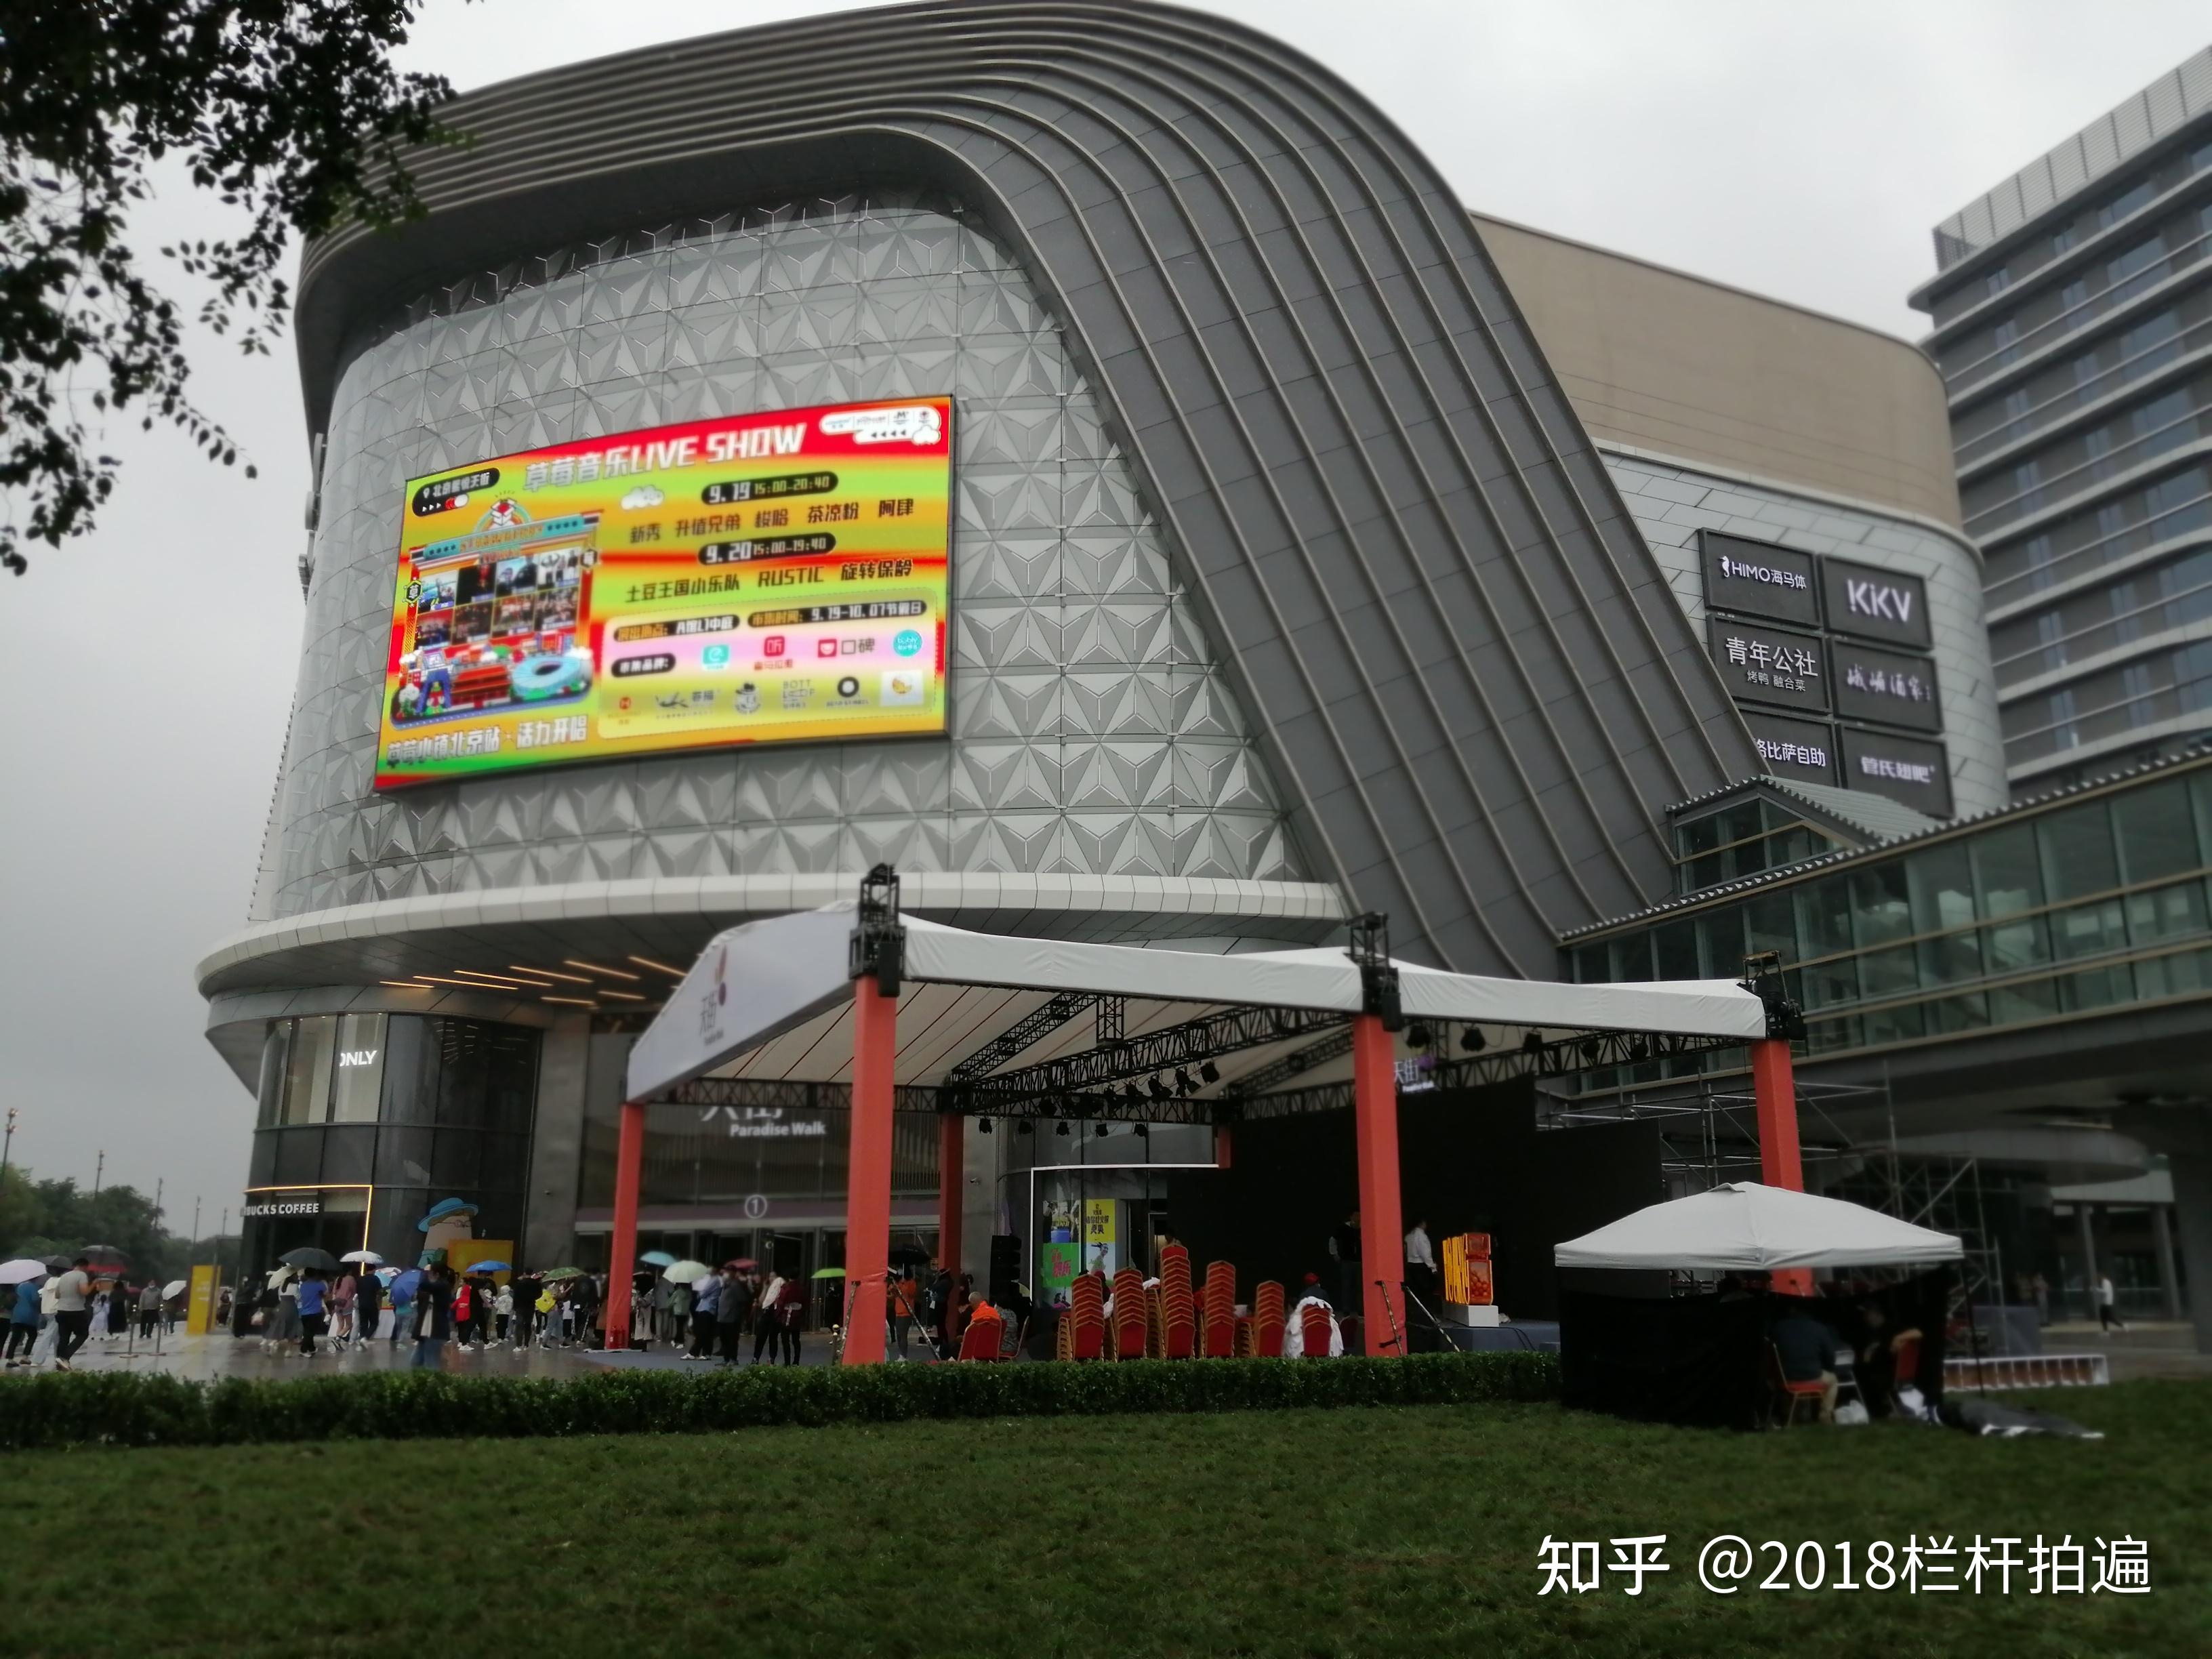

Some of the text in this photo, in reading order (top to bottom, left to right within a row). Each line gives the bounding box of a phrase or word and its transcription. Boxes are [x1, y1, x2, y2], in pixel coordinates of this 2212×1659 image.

[524, 423, 806, 492] 草莓音乐LIVE SHOW
[630, 524, 661, 543] 新秀
[808, 502, 859, 524] 茶凉粉
[878, 499, 914, 518] 阿肆
[626, 559, 913, 602] 土豆王国小乐队 RUSTIC 旋转保龄
[1731, 560, 1807, 590] HIMO海马体
[1847, 579, 1911, 622] KKV
[841, 638, 875, 655] 口碑
[1725, 637, 1818, 677] 青年公社
[1747, 670, 1806, 691] 烤鸭 融合菜
[517, 716, 588, 749] 活力开唱
[1861, 756, 1930, 783] 管氏翅吧
[730, 1121, 826, 1137] Paradise Walk
[279, 1203, 319, 1214] COFFEE
